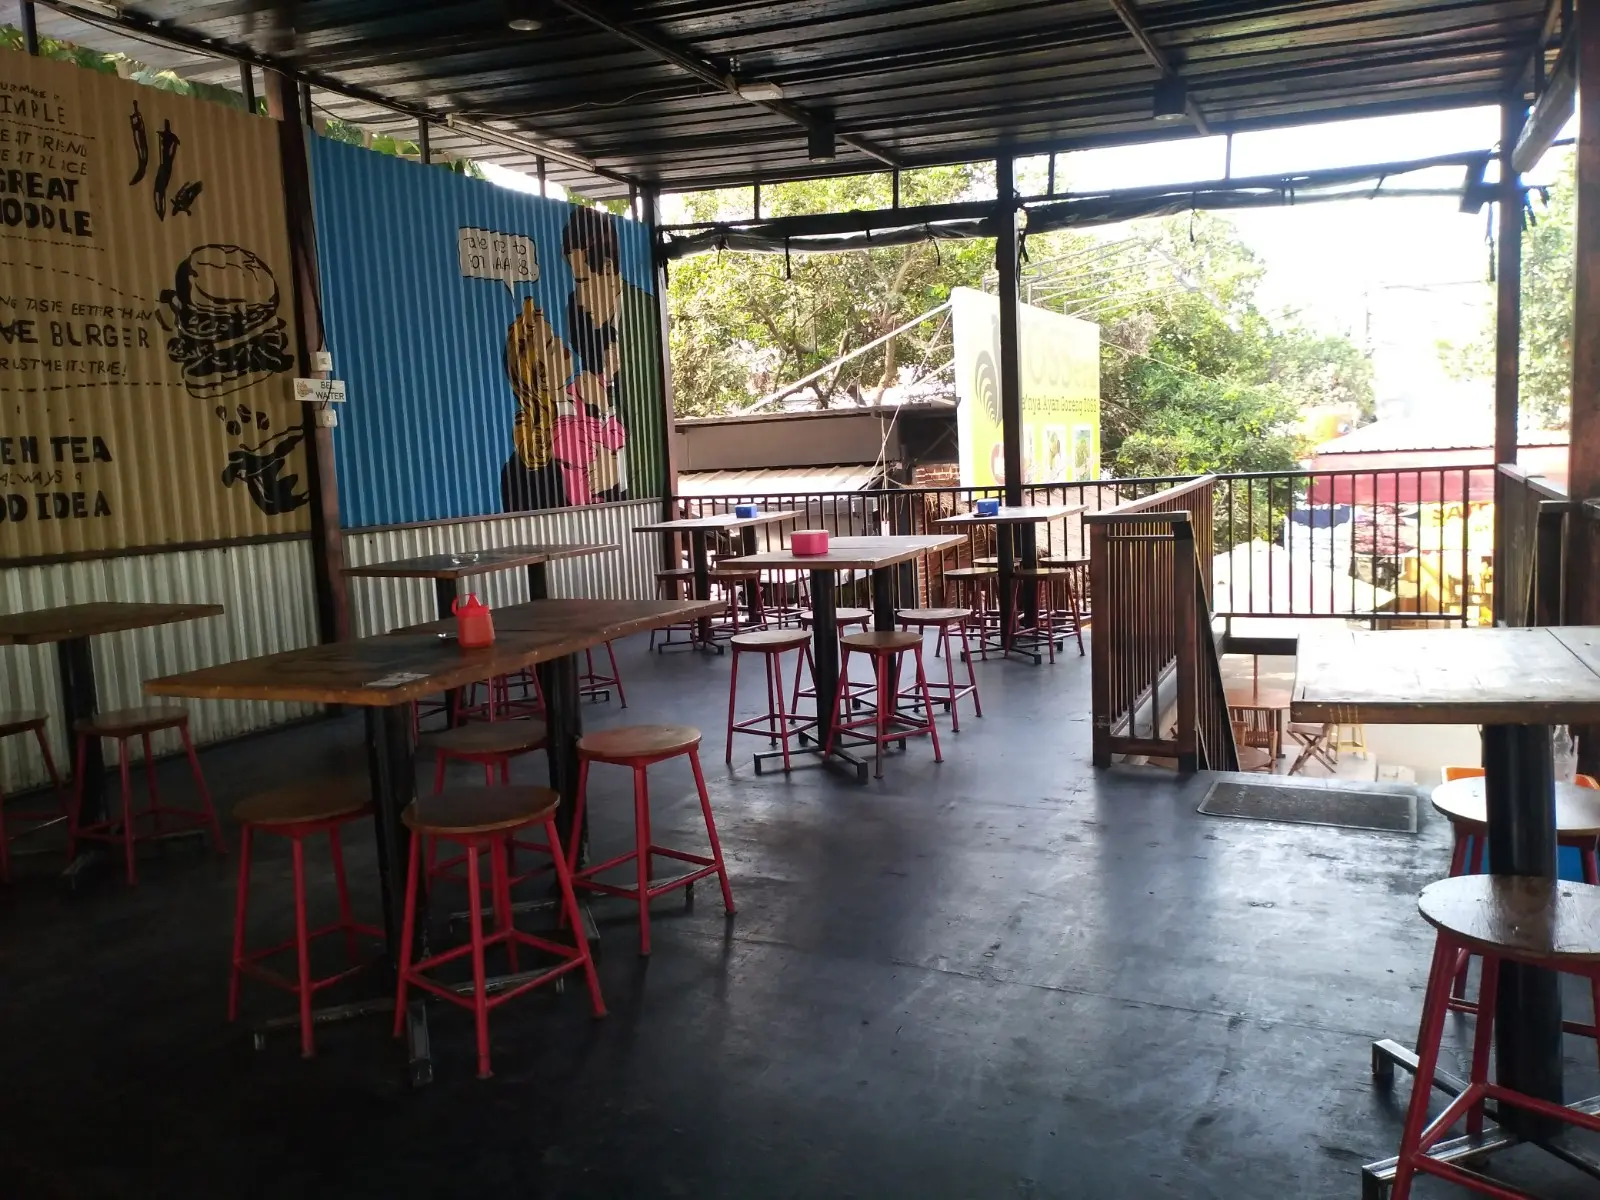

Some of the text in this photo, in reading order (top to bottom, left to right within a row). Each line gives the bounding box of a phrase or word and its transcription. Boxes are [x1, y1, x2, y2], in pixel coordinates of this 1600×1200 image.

[38, 134, 88, 158] RIEND
[0, 197, 93, 238] OODLE
[26, 297, 63, 313] TASTE
[50, 436, 113, 463] TEA
[35, 490, 112, 520] IDEA
